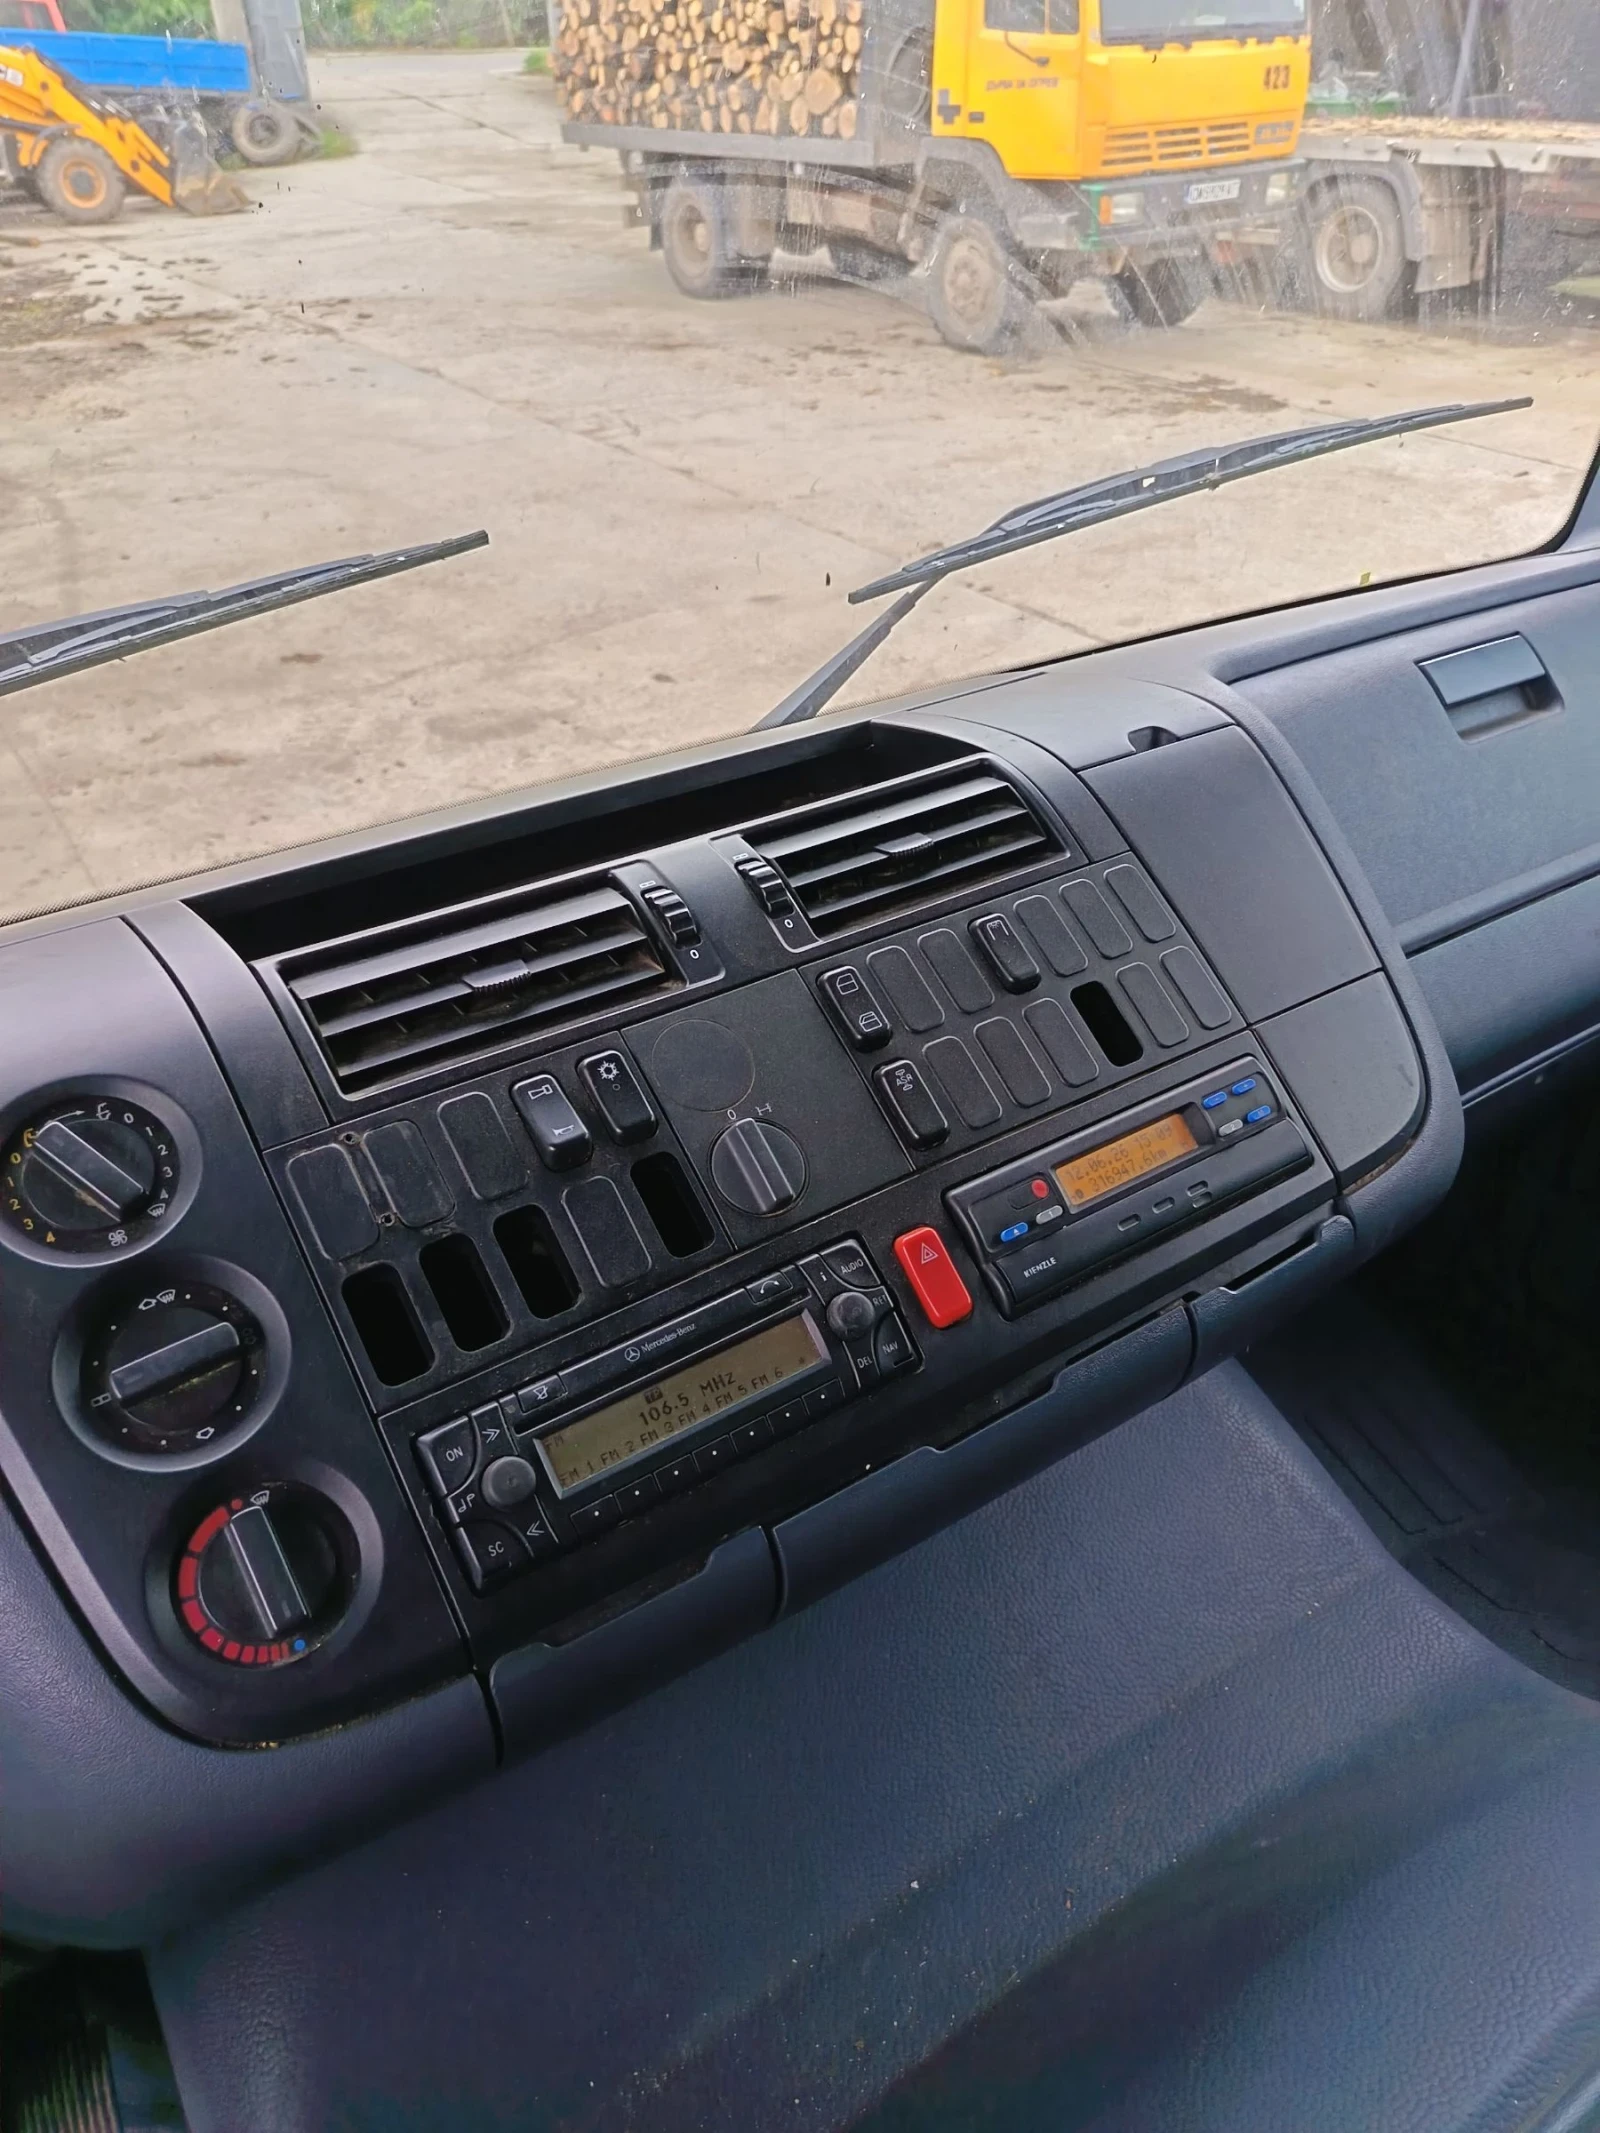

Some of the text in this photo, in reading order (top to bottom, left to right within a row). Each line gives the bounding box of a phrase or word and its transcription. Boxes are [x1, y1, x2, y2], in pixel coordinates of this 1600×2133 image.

[1263, 65, 1290, 90] 423
[124, 1112, 173, 1200] 0 1 2 3 4
[7, 1152, 56, 1243] 0 1 2 3 4
[840, 1259, 864, 1275] AUDIO
[1023, 1256, 1057, 1279] KIENZLE
[872, 1295, 887, 1307] RET
[641, 1323, 696, 1353] Mercedes-Benz
[882, 1341, 898, 1355] NAV
[857, 1355, 873, 1369] DEL
[639, 1372, 736, 1426] 106.5 MHz
[560, 1366, 783, 1488] FM 1 FM 2 FM 3 FM 4 FM 5 FM 6
[445, 1446, 464, 1462] ON
[488, 1541, 505, 1557] SC
